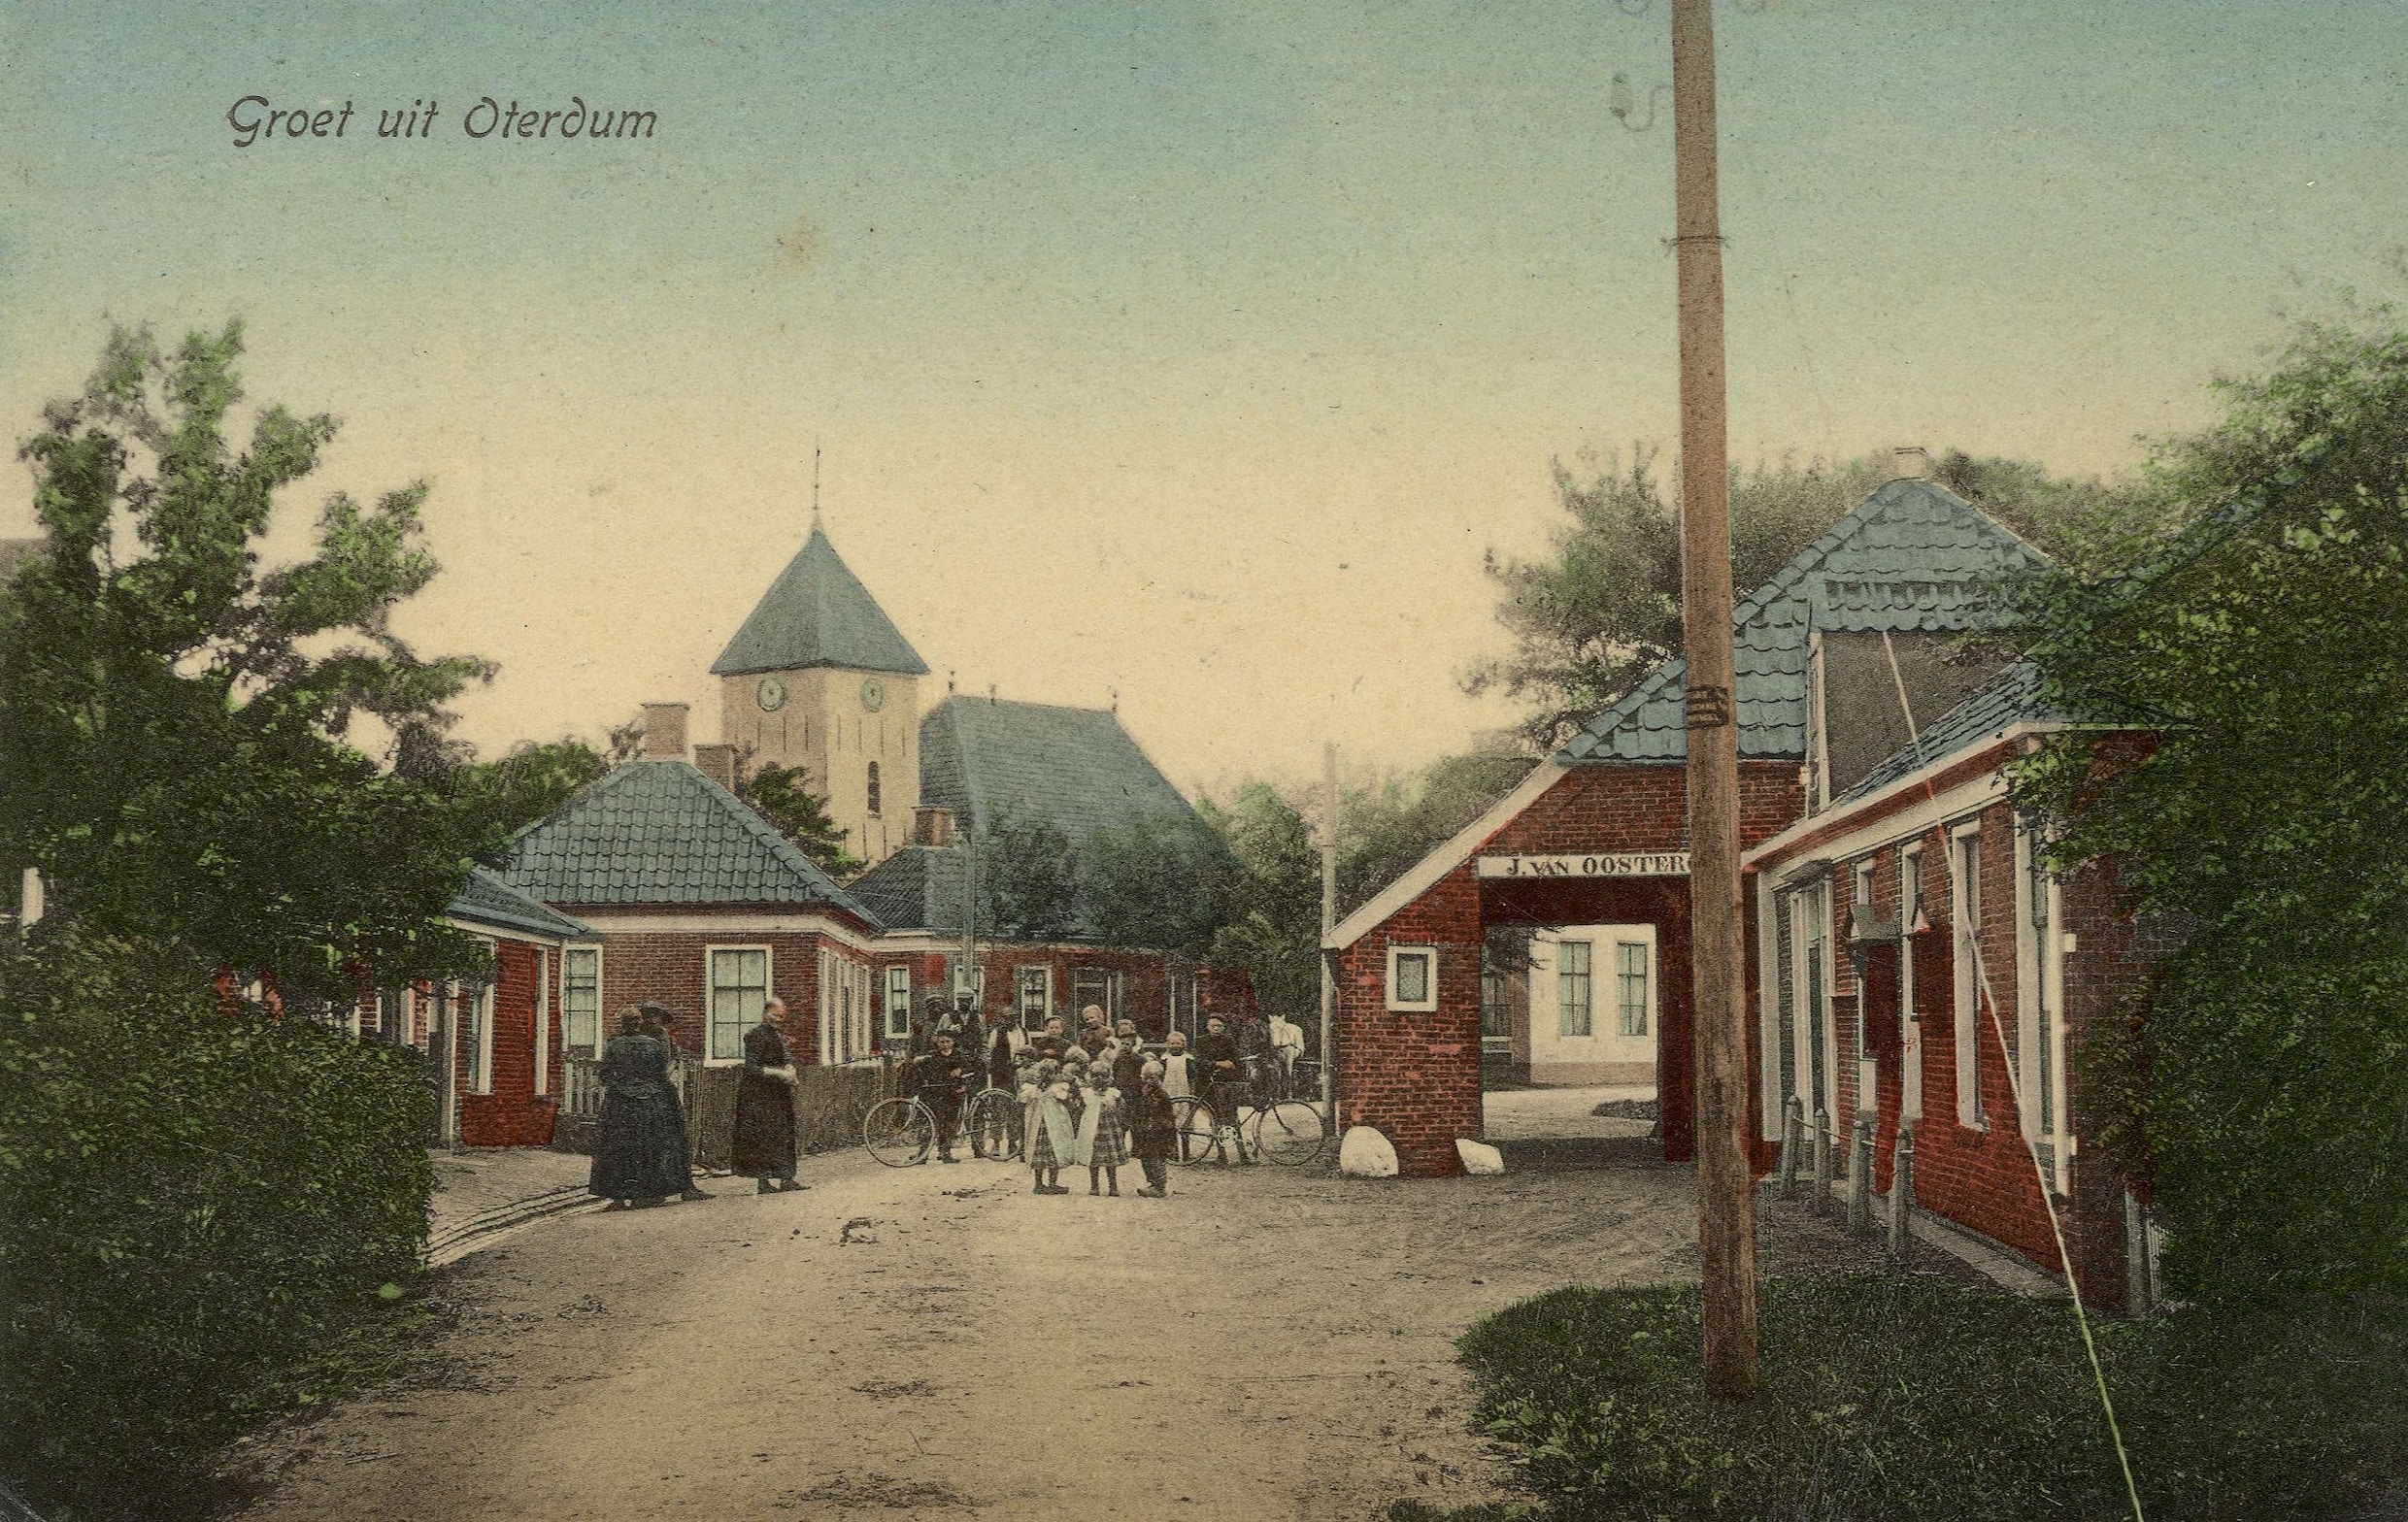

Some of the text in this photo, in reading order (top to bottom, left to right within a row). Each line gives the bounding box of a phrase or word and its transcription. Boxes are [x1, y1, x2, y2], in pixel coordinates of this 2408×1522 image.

[1507, 855, 1691, 875] J. VAN OOSTER
